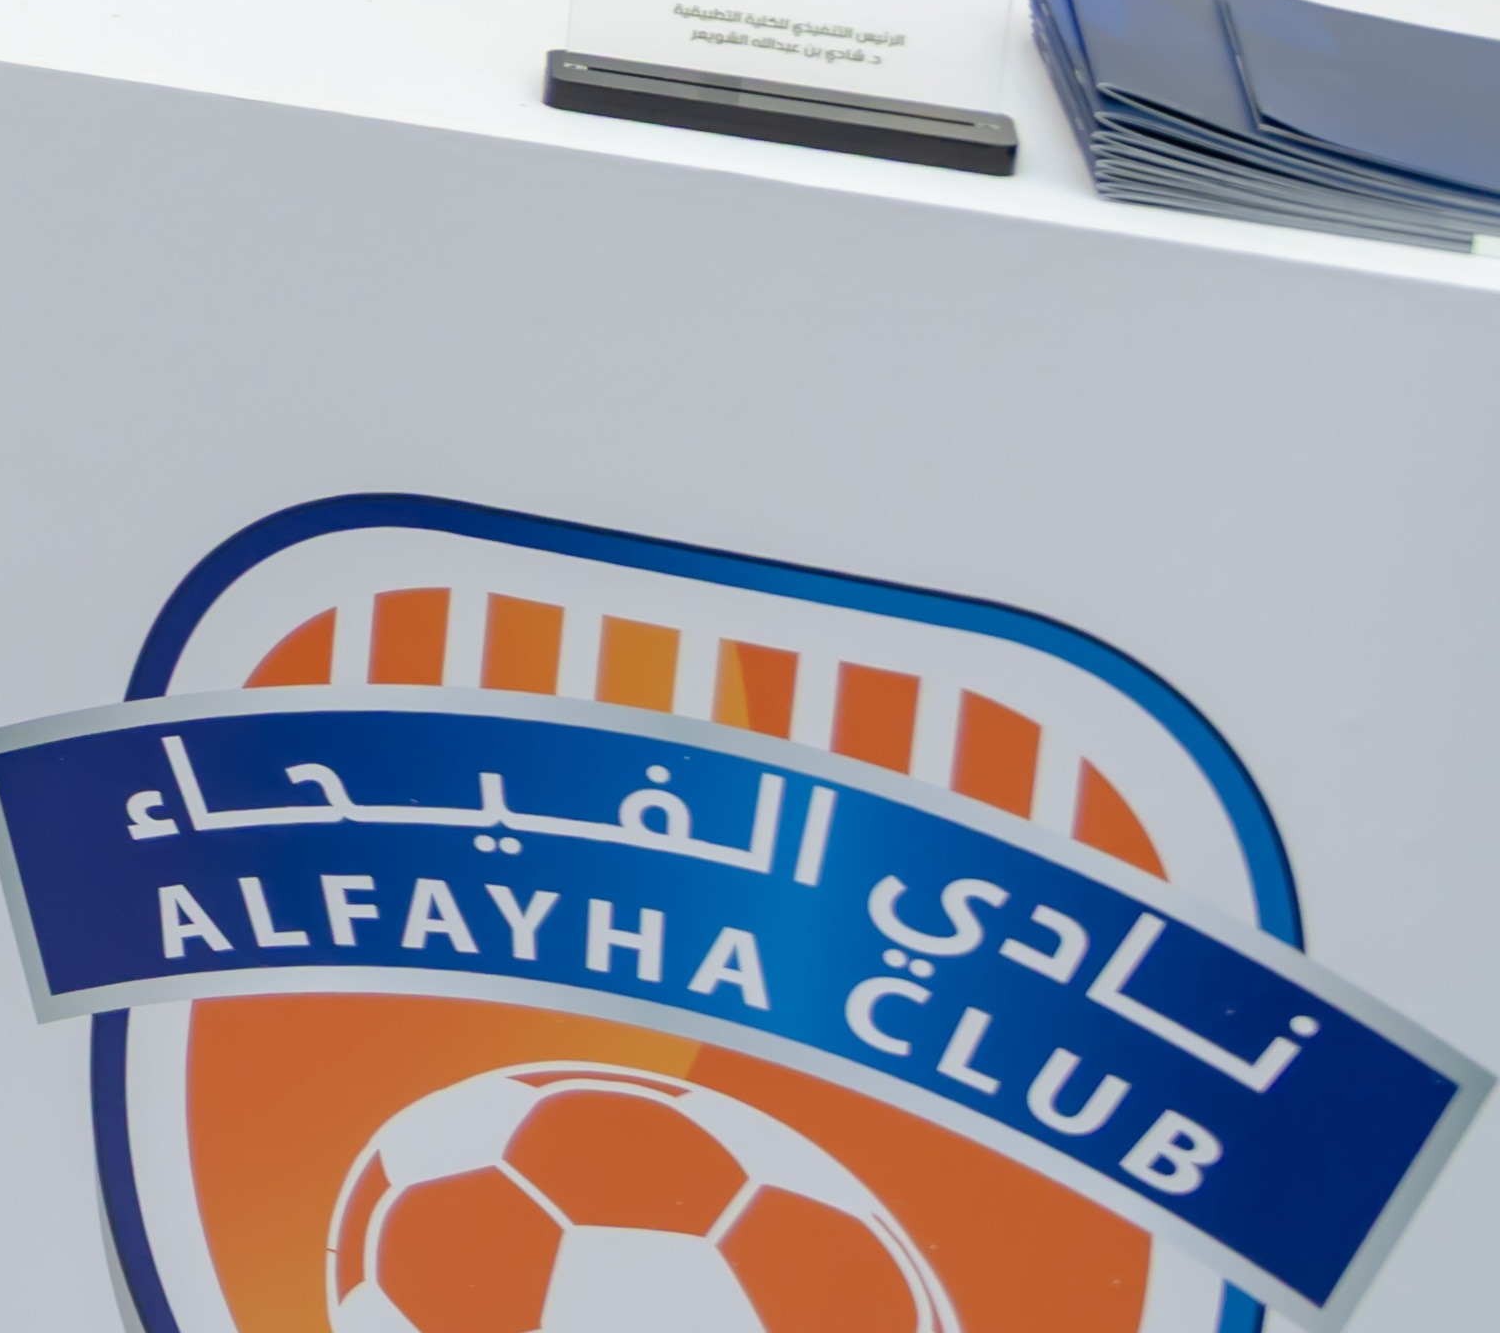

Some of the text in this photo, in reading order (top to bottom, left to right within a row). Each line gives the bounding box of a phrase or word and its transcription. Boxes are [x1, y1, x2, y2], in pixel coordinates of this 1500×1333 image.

[122, 733, 1323, 1093] نادي الفيحاء
[154, 873, 1225, 1198] ALFAYHA CLUB
